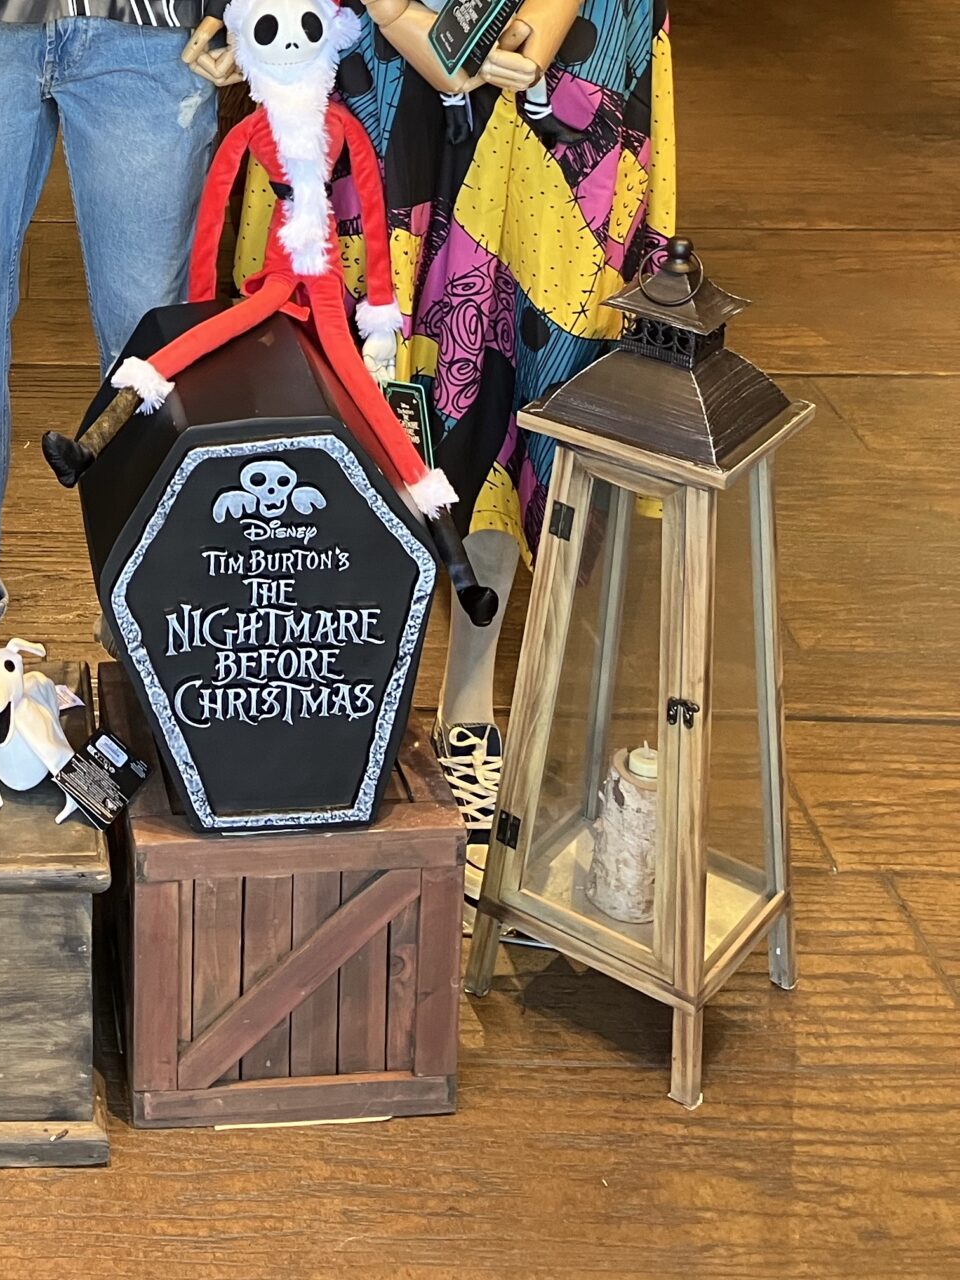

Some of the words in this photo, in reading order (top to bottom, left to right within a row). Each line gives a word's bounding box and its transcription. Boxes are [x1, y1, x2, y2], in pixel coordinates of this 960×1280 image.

[240, 519, 318, 545] Disney
[202, 550, 245, 577] TIM
[247, 547, 350, 576] BURTON'S
[242, 578, 298, 607] THE
[165, 603, 386, 657] NIGHTMARE
[211, 647, 345, 687] BEFORE
[174, 680, 375, 729] CHRISTMAS
